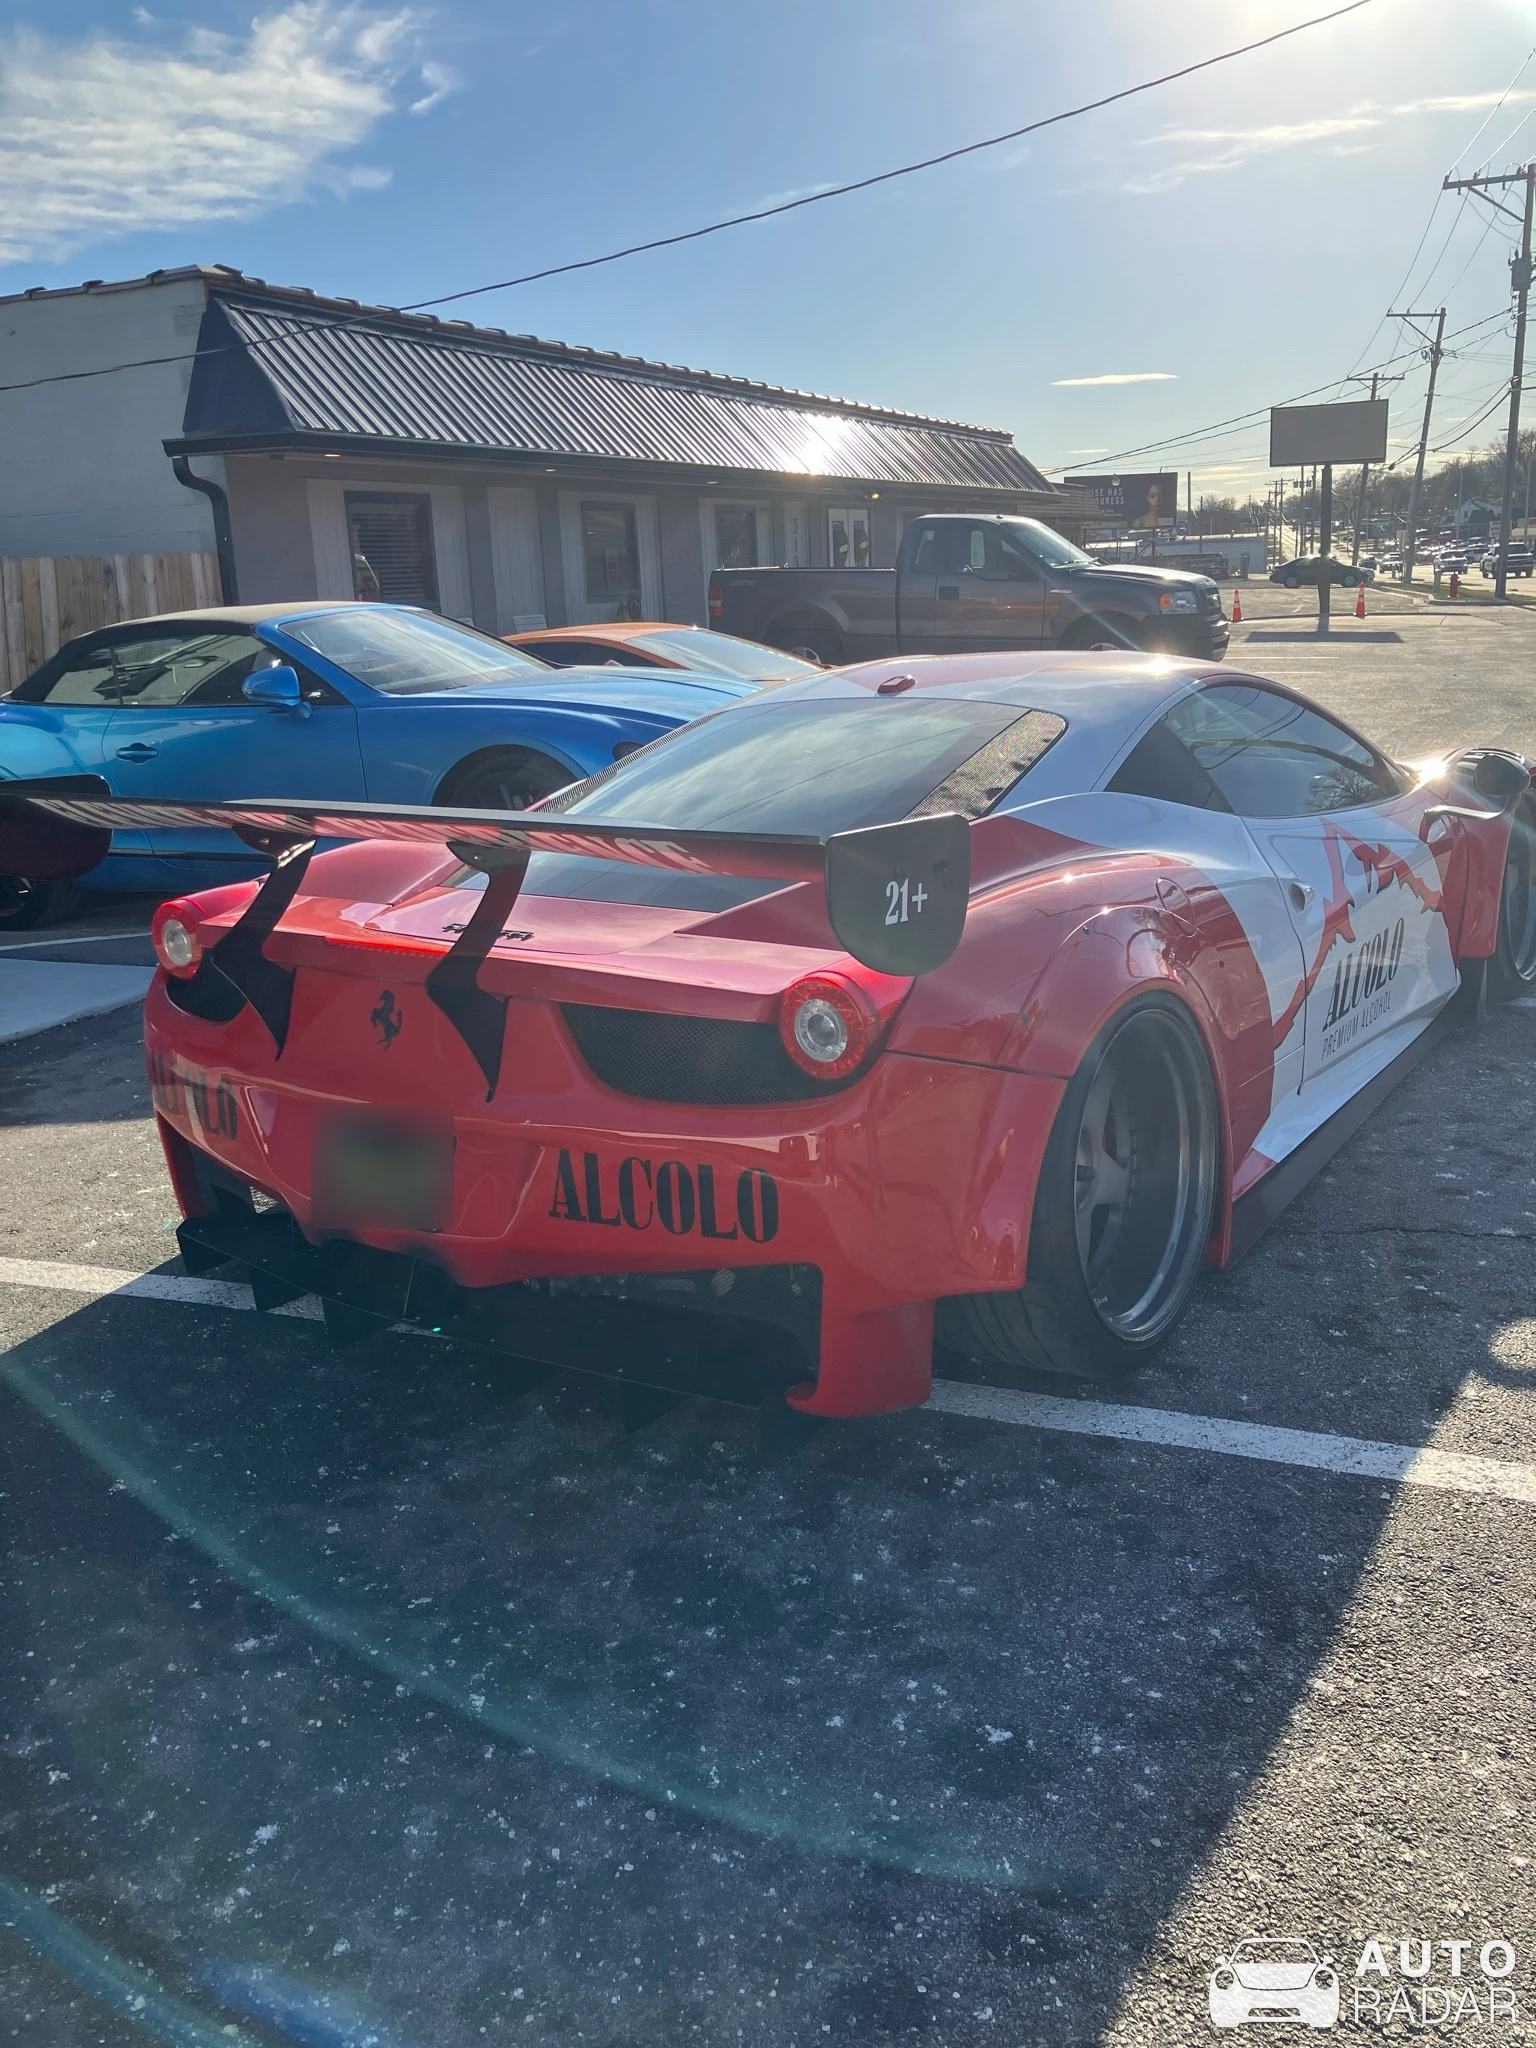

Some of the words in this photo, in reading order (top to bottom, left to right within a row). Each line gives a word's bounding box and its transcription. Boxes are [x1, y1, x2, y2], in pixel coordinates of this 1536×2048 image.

[1094, 496, 1125, 505] DDRESS
[1107, 487, 1123, 497] HAS
[885, 878, 928, 926] 21+
[1322, 917, 1405, 1032] ALCOLO
[1321, 1017, 1359, 1061] PREMIUM
[1361, 990, 1392, 1030] ALCOHOL
[548, 1148, 779, 1243] ALCOLO
